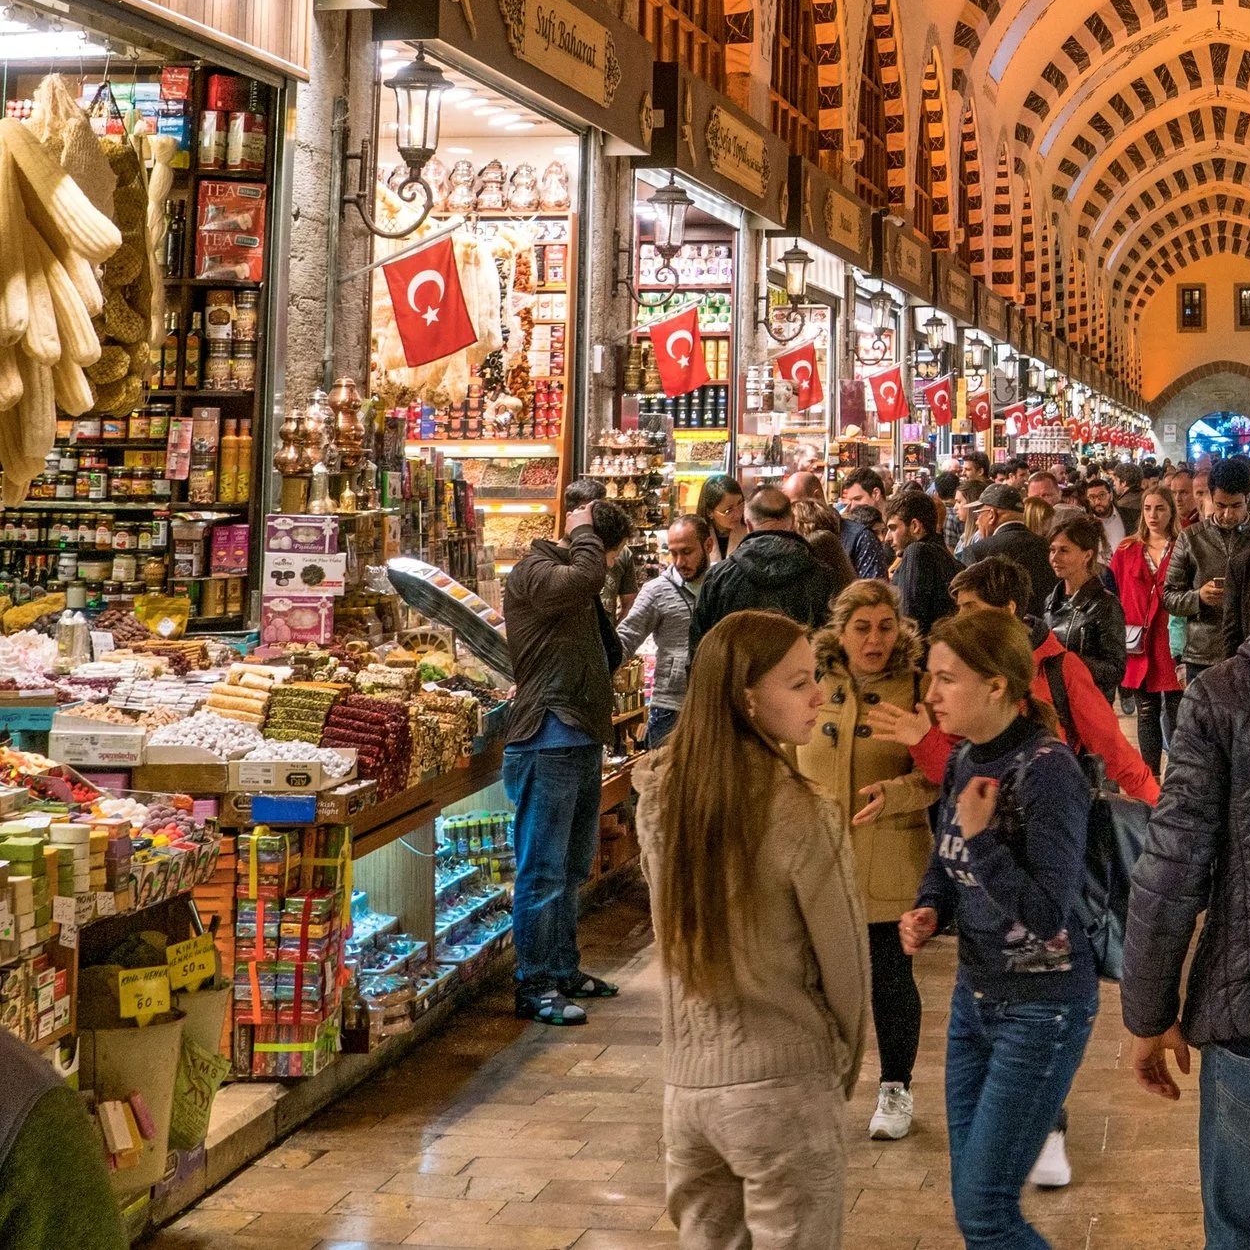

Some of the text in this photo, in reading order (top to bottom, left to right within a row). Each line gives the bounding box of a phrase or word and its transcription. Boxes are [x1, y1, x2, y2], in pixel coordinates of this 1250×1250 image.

[535, 5, 596, 69] Sufi Baharat
[644, 107, 652, 129] 45
[206, 183, 237, 197] TEA
[202, 233, 233, 247] TEA
[175, 940, 198, 955] KINA
[182, 961, 196, 976] 50
[136, 997, 152, 1009] 60
